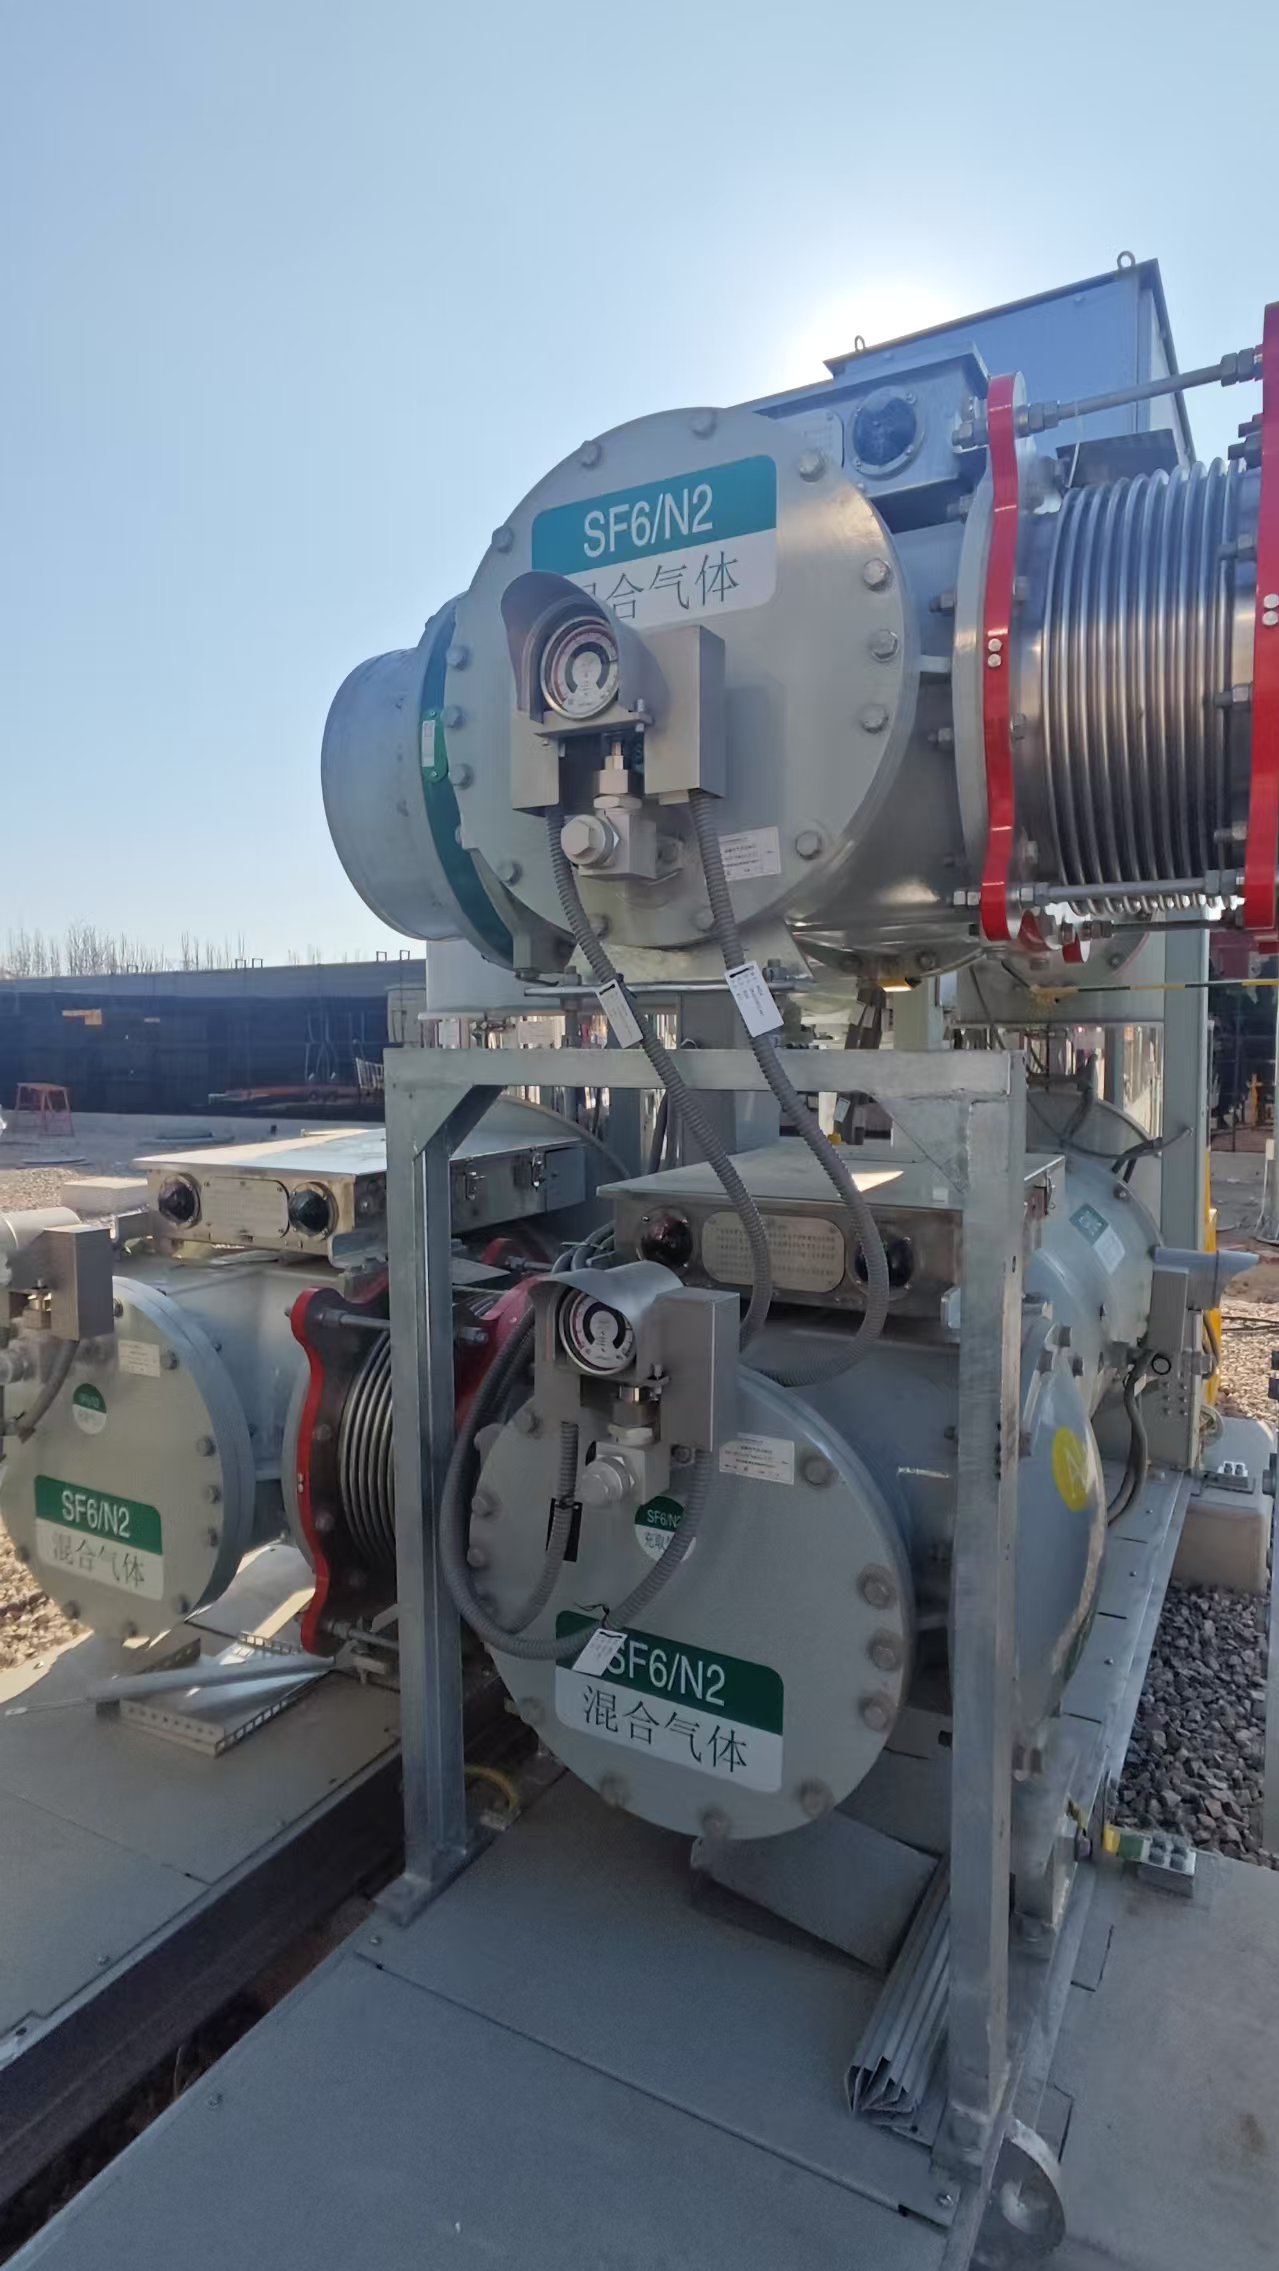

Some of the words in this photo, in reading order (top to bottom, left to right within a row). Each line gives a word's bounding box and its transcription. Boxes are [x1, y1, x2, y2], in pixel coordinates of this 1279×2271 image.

[583, 483, 713, 558] SF6/N2
[583, 551, 739, 619] 合气体
[61, 1490, 131, 1538] SF6/N2
[52, 1533, 145, 1588] 混合气体
[583, 1685, 747, 1773] 混合气体
